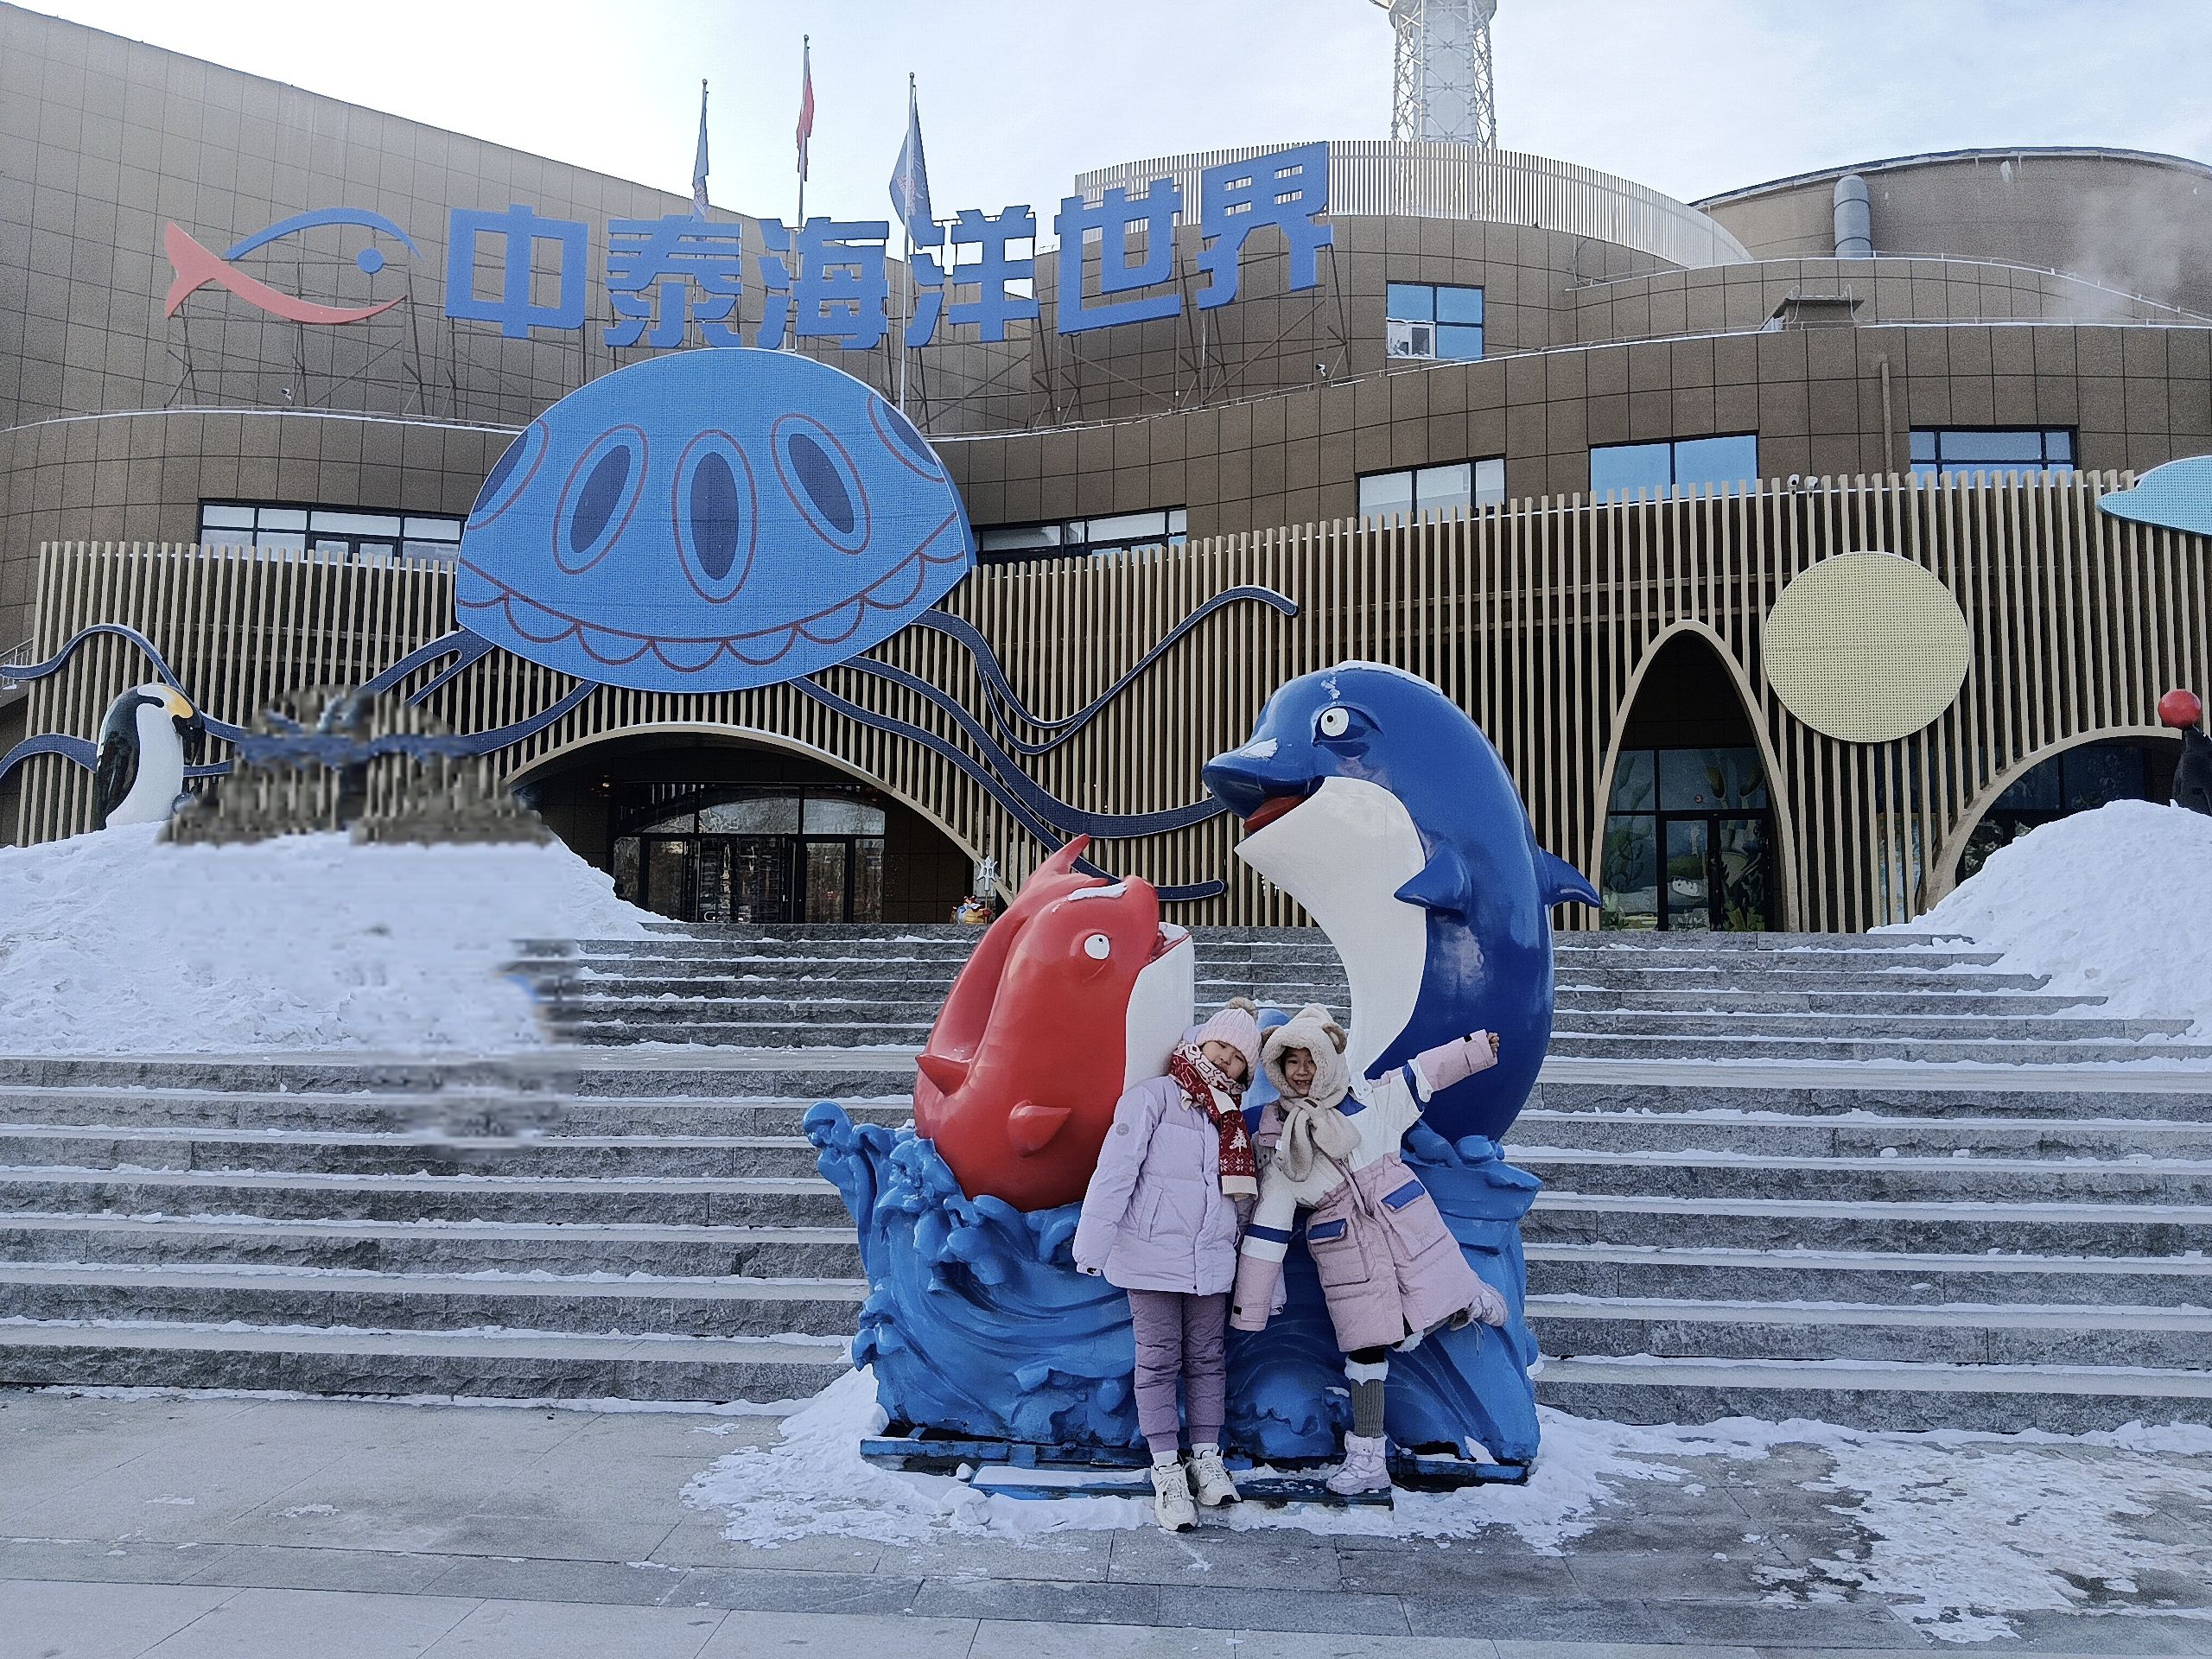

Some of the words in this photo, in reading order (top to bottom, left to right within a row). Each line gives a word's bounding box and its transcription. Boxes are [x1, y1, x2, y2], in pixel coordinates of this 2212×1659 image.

[446, 141, 1332, 349] 中泰海洋世界
